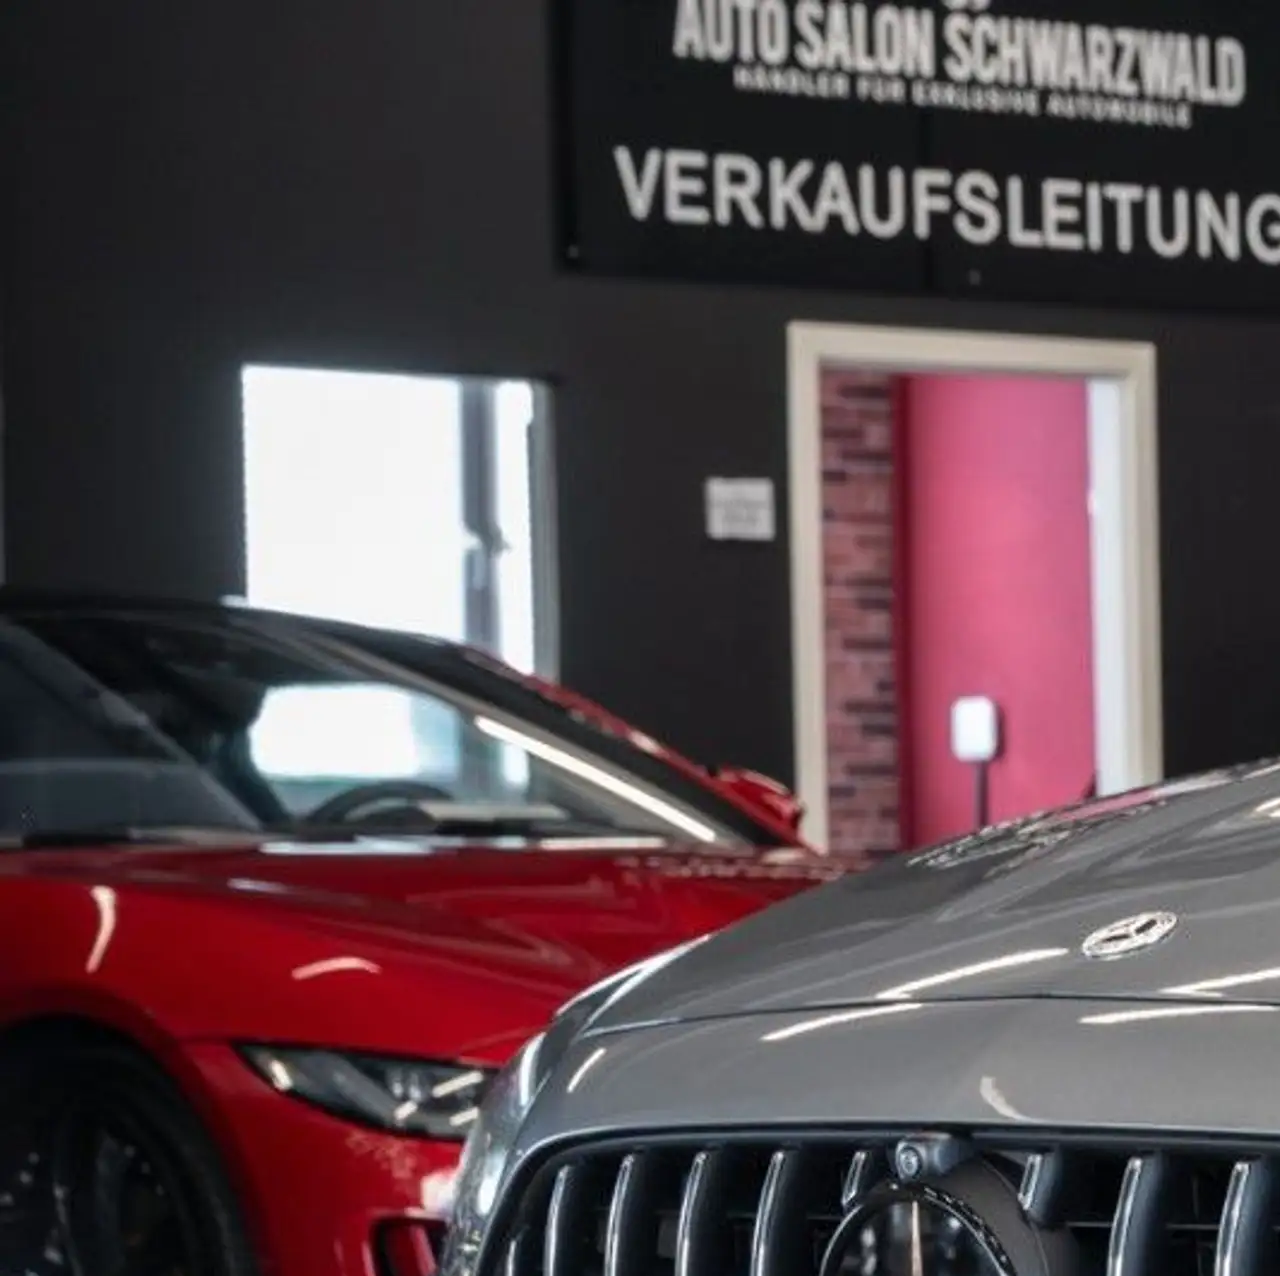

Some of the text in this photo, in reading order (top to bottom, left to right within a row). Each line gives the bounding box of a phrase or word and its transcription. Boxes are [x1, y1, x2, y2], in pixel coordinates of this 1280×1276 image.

[673, 0, 1246, 107] AUTO SALON SCHWARZWALD
